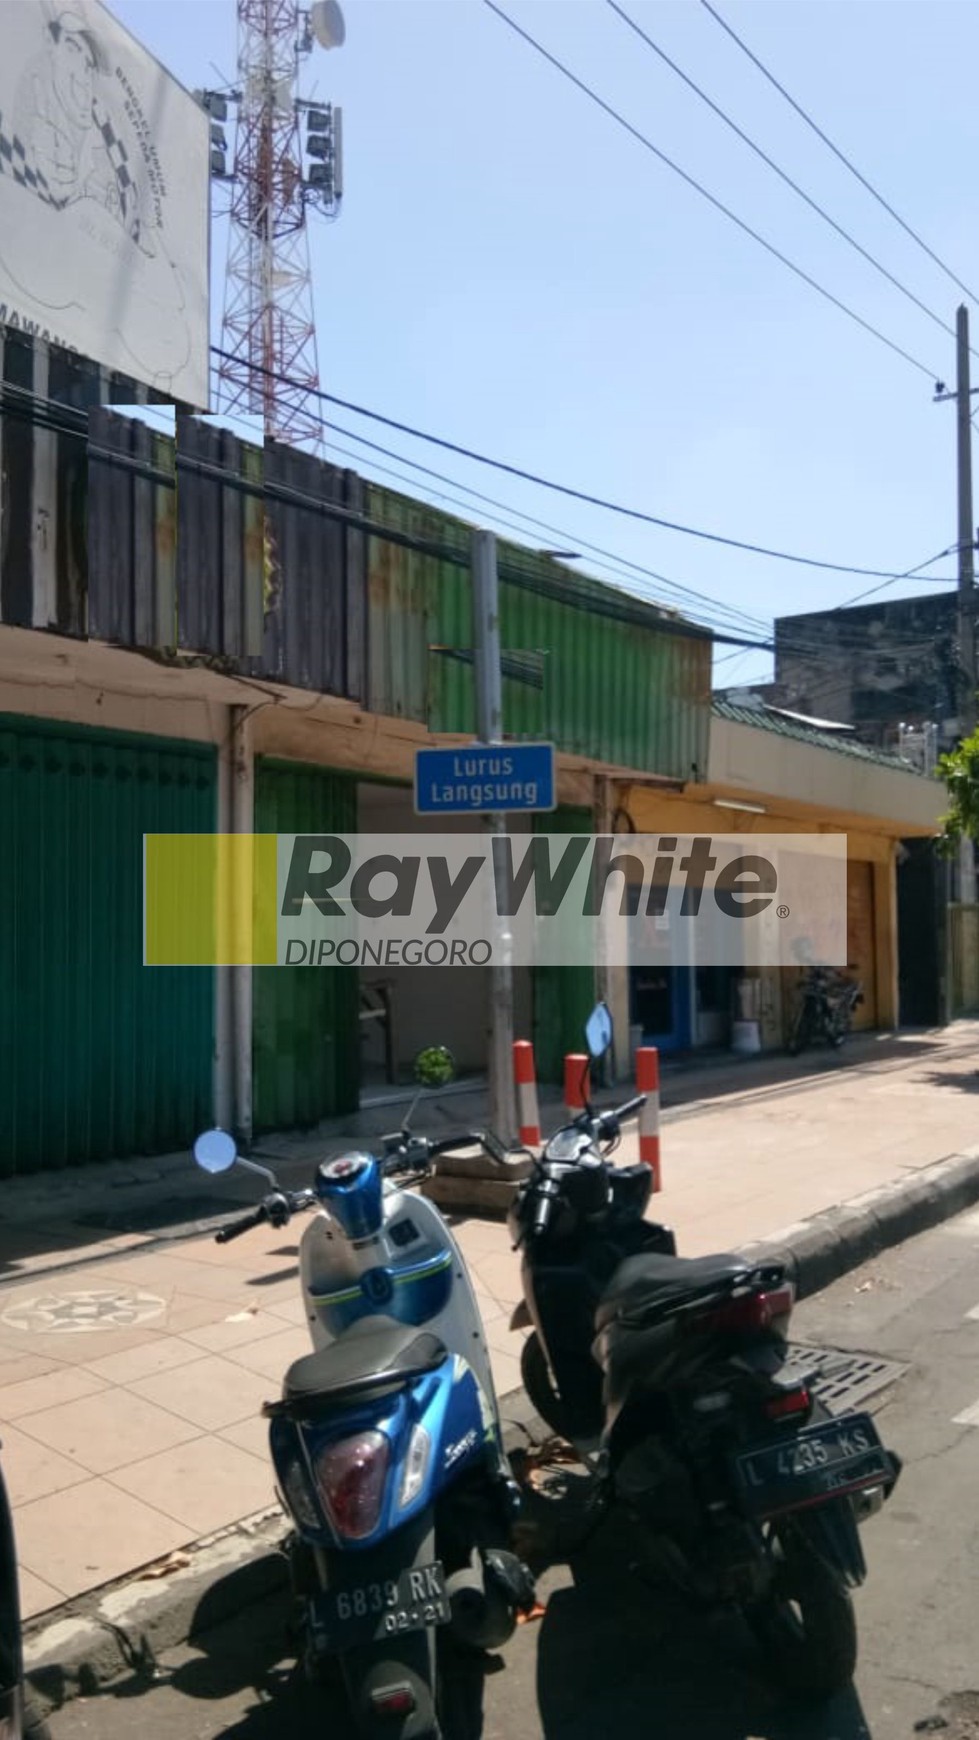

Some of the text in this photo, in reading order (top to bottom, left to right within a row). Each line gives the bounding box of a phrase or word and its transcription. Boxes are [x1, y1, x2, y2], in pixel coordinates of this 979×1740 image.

[454, 757, 513, 777] Lurus
[432, 782, 537, 807] Langsung
[745, 1460, 764, 1486] L
[837, 1428, 869, 1457] KS
[308, 1566, 442, 1628] L 6839 RK
